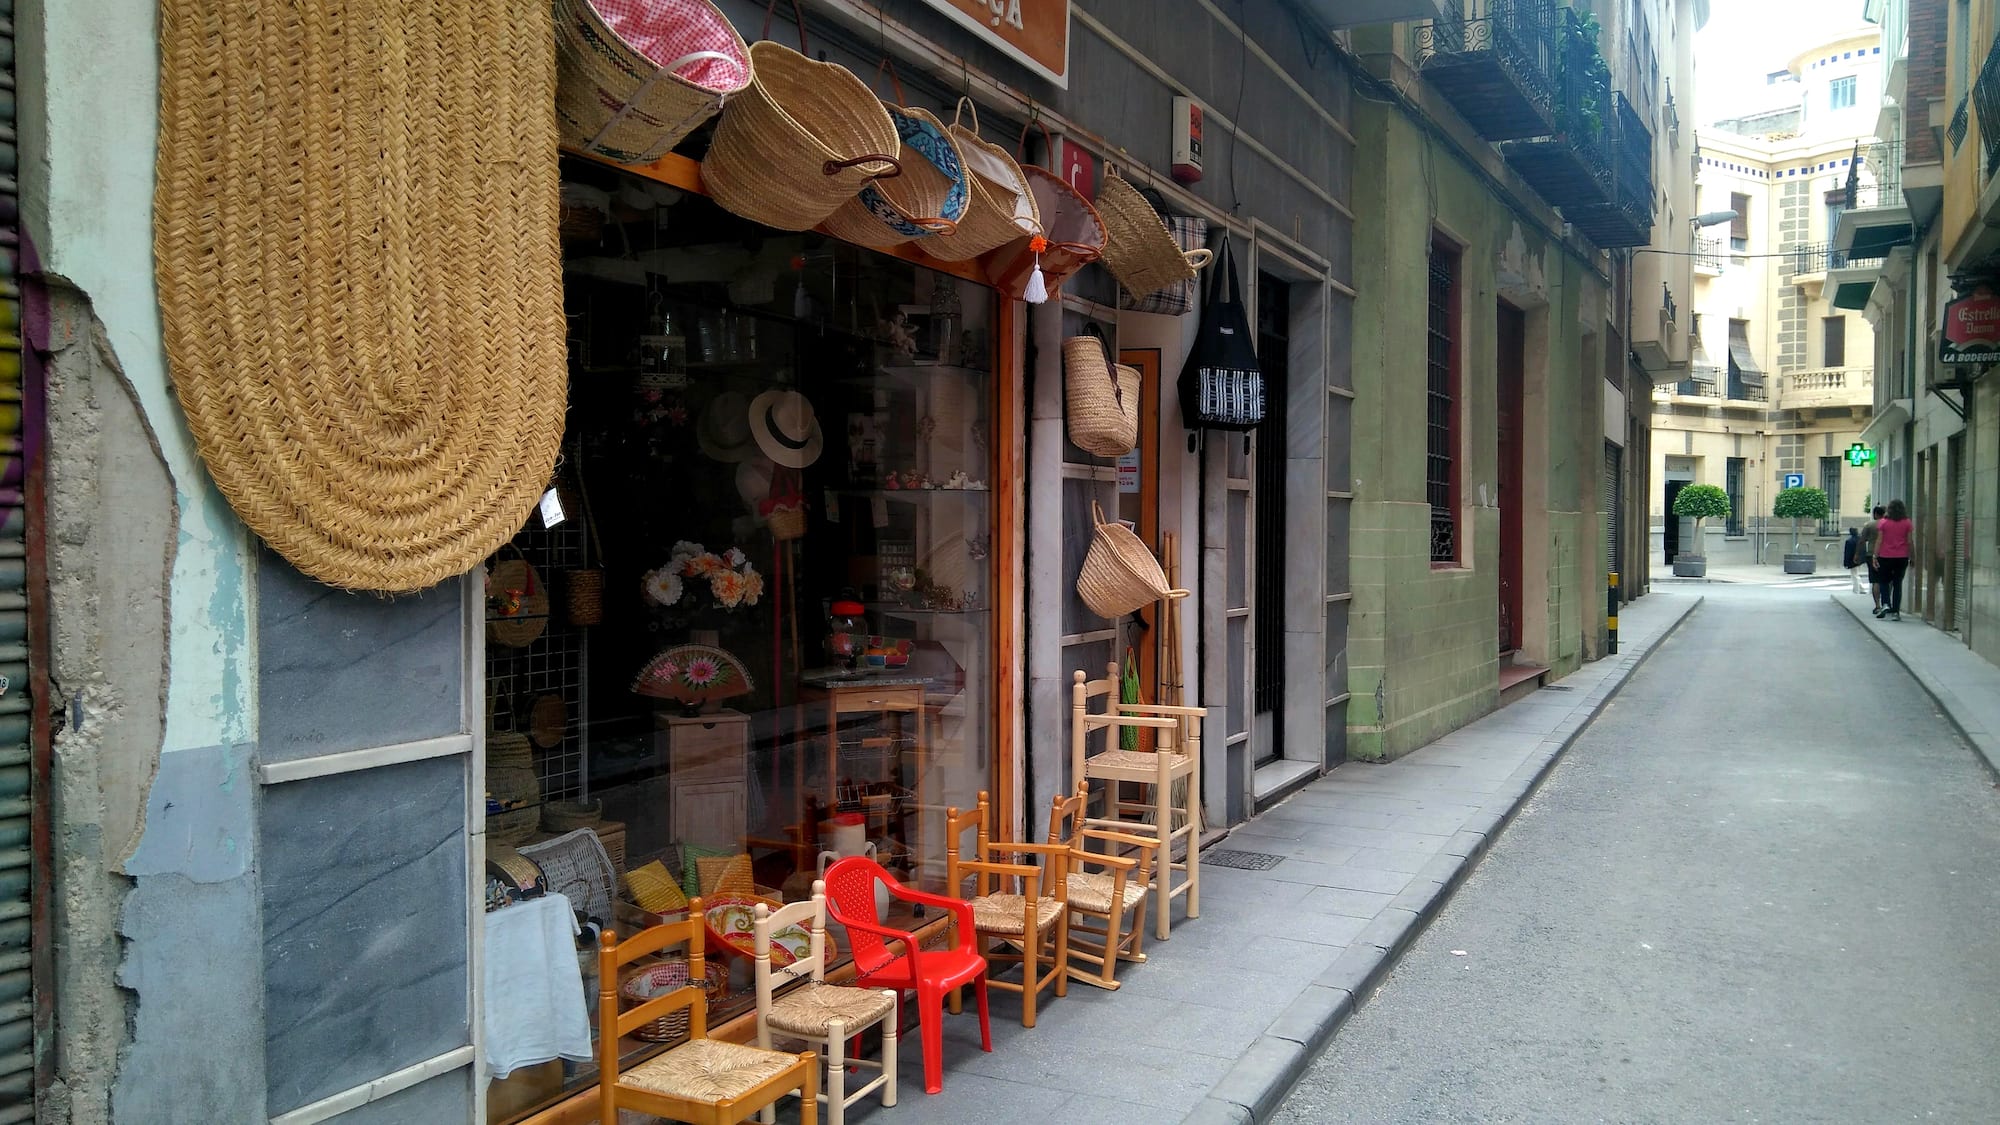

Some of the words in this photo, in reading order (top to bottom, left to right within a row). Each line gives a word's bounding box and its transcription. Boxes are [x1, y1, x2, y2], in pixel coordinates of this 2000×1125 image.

[977, 0, 1024, 30] ÇA
[1943, 353, 1955, 363] LA
[1788, 476, 1800, 489] P
